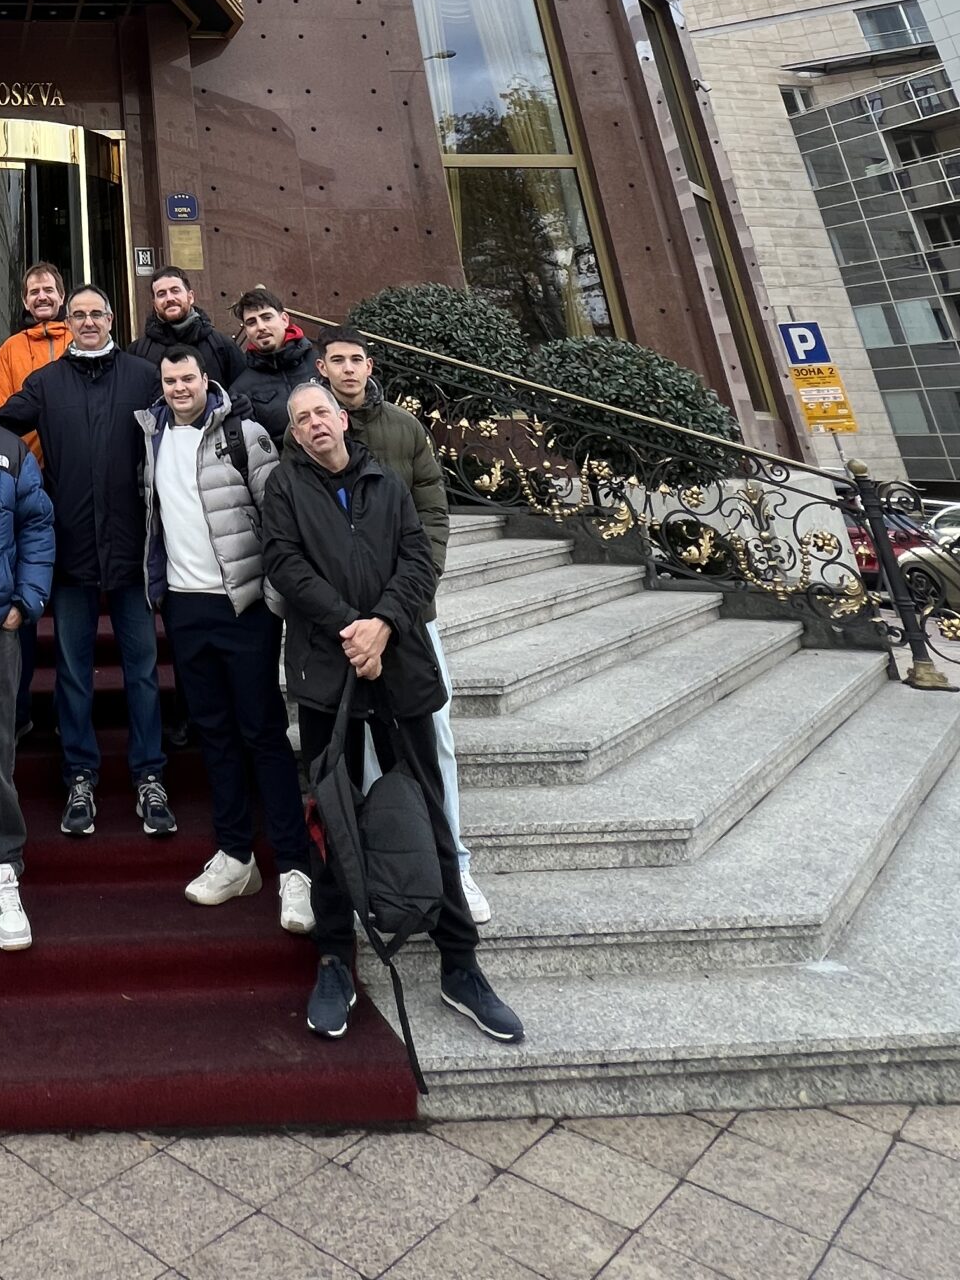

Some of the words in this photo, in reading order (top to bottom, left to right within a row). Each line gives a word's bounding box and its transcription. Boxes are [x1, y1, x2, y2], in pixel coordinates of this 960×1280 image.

[788, 327, 816, 360] P
[793, 367, 824, 377] ЗОНА
[827, 367, 835, 375] 2
